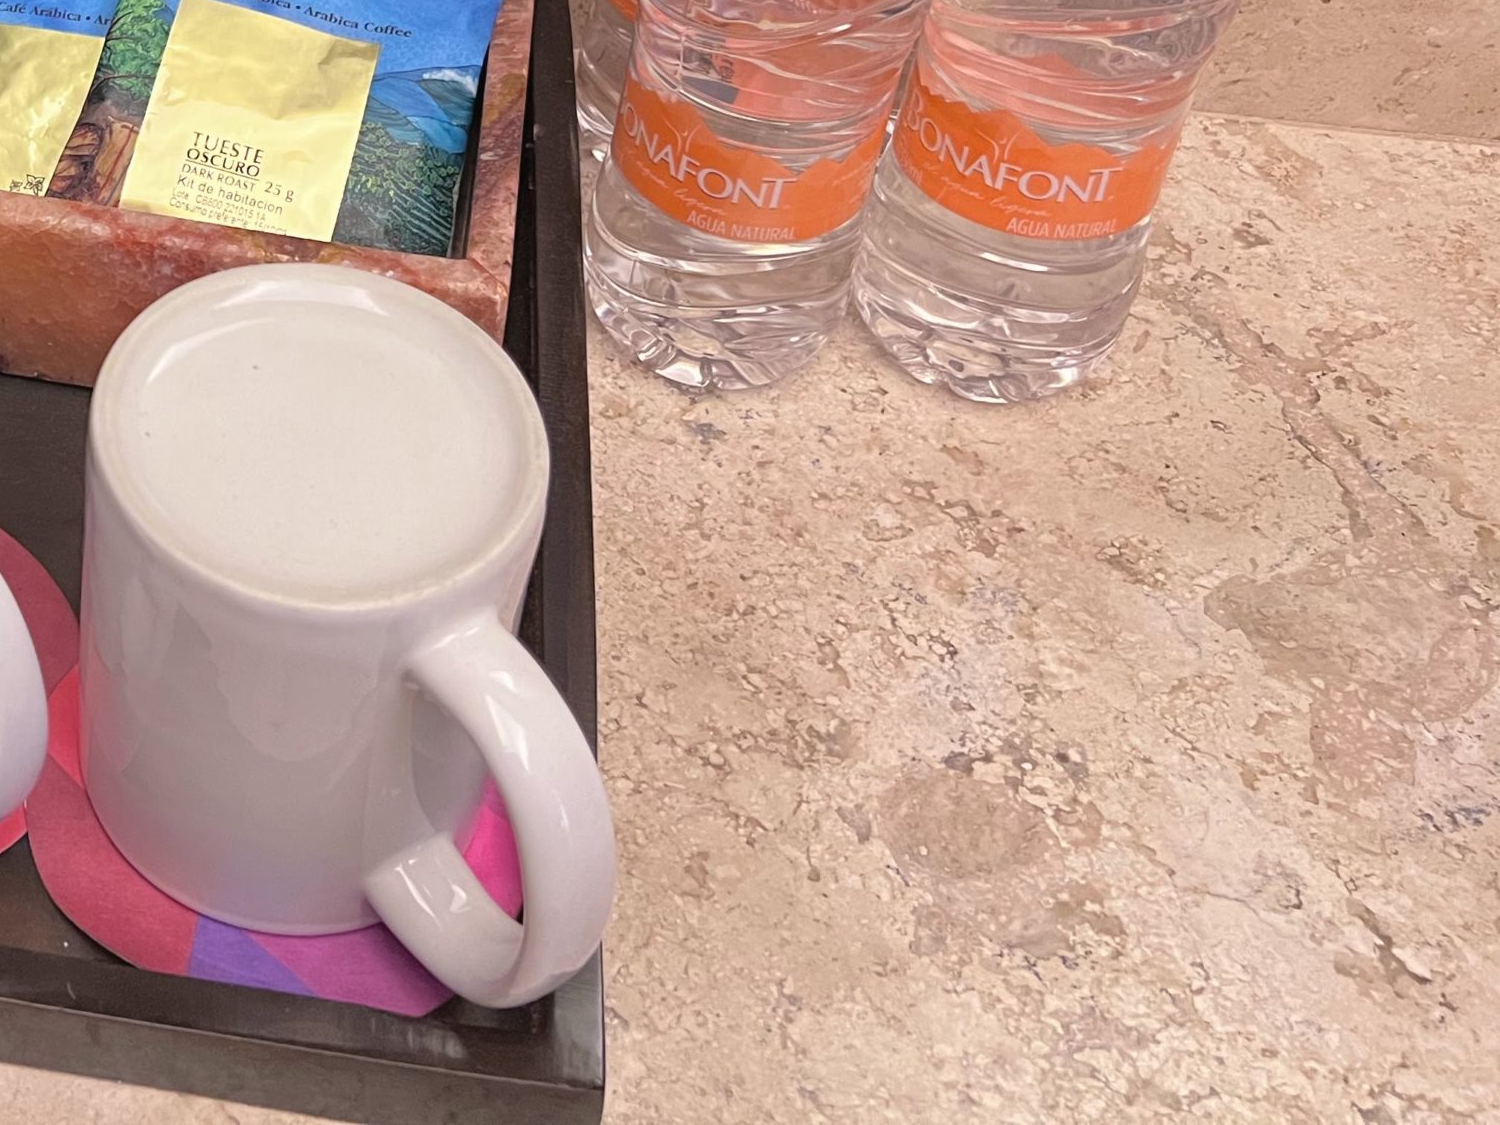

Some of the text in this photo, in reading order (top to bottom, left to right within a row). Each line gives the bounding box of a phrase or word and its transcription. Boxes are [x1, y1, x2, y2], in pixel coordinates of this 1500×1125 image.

[303, 6, 359, 30] Arabica
[364, 21, 413, 38] Coffee
[193, 131, 264, 164] TUESTE
[621, 101, 797, 209] ONAFONT
[904, 87, 1123, 203] BONAFONT
[187, 148, 260, 177] OSCURO
[177, 175, 283, 216] Kit de habitacion
[182, 163, 294, 203] DARK ROAST 25 g
[686, 210, 796, 241] AGUA NATURAL
[1006, 217, 1116, 239] AGUA NATURAL
